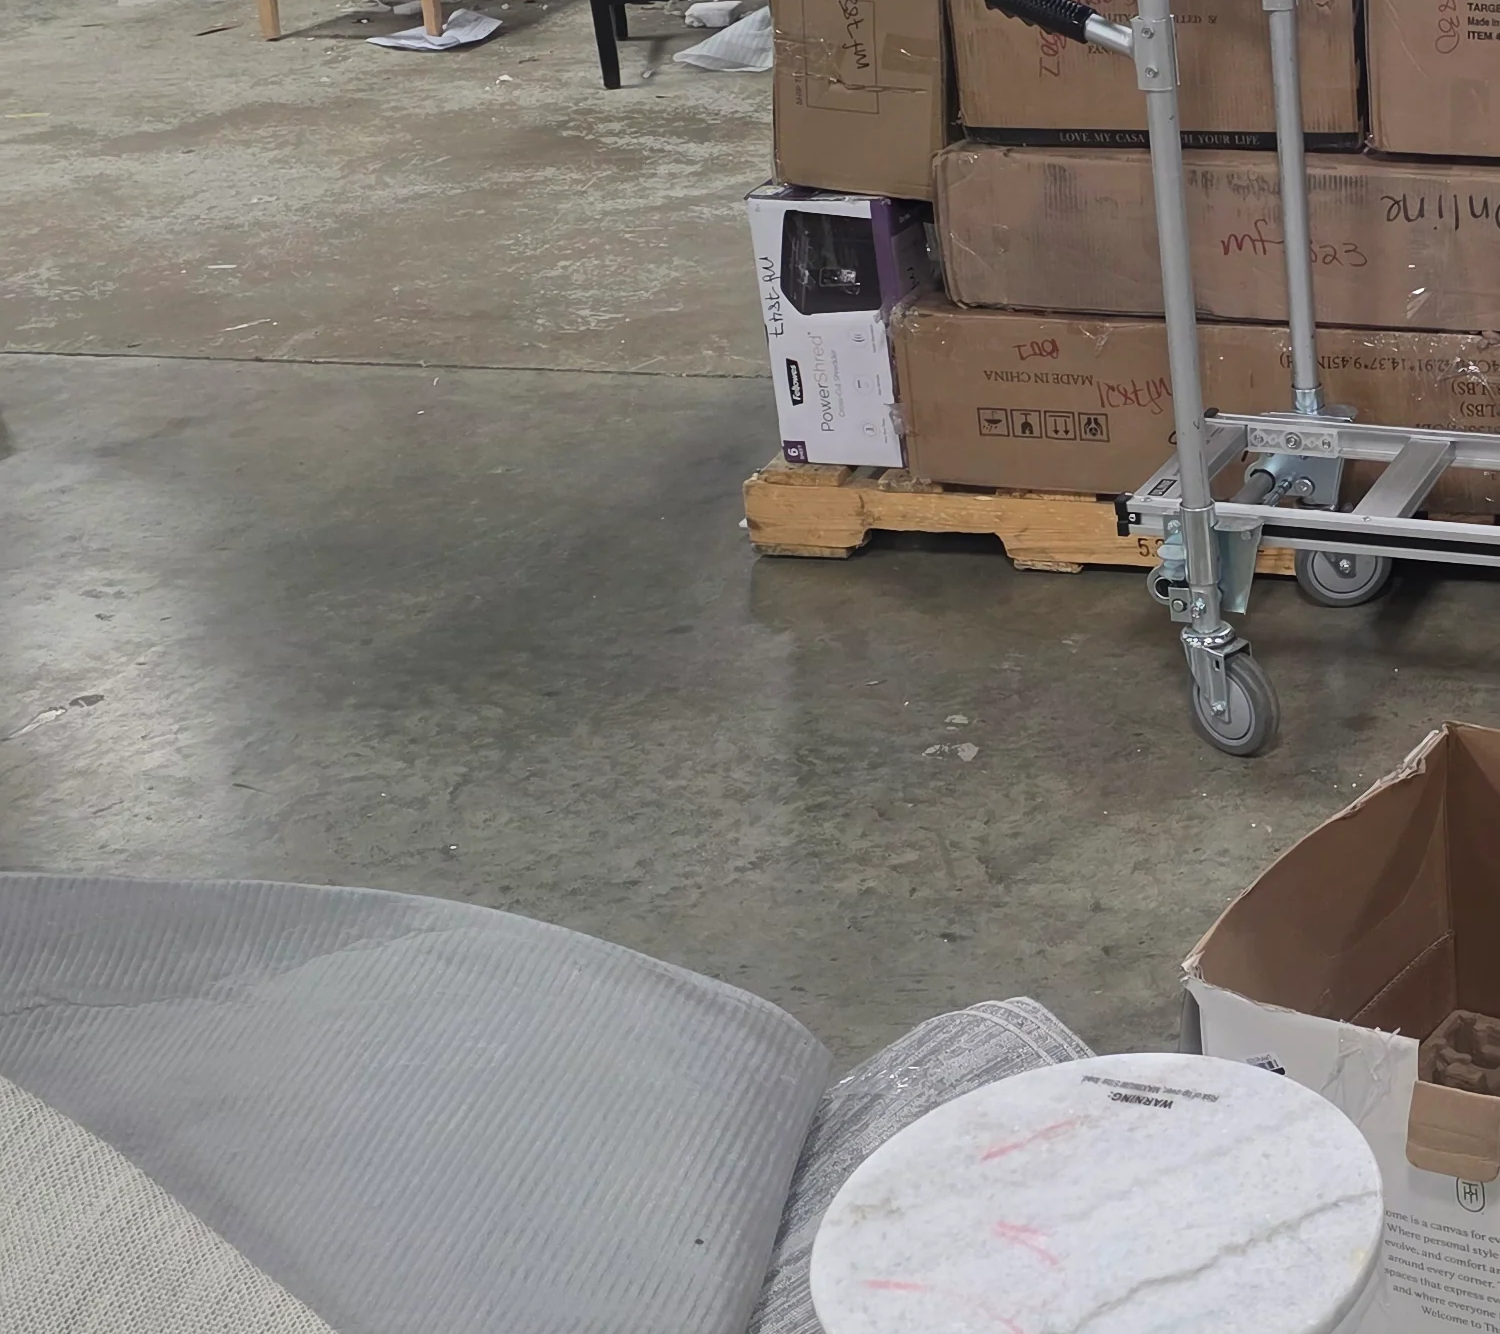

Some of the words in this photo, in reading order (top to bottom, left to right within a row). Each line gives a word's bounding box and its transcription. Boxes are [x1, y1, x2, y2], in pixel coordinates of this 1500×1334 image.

[1467, 17, 1489, 27] Made
[1467, 31, 1493, 41] ITEM
[1059, 132, 1090, 143] LOVE
[1095, 132, 1111, 143] MY
[1115, 133, 1145, 144] CASA
[1198, 134, 1230, 145] YOUR
[1235, 135, 1260, 146] LIFE
[790, 364, 802, 401] Fellowes
[812, 334, 836, 432] PowerShred
[983, 370, 1032, 384] CHINA
[1034, 372, 1050, 384] IN
[1052, 373, 1093, 386] MADE
[788, 447, 799, 457] 6
[1108, 1091, 1174, 1109] WARNING:
[1385, 1210, 1408, 1222] ome
[1410, 1214, 1419, 1225] is
[1430, 1222, 1469, 1238] canvas
[1471, 1229, 1486, 1242] for
[1387, 1222, 1421, 1241] Where
[1423, 1234, 1469, 1253] personal
[1472, 1245, 1499, 1261] style
[1384, 1239, 1420, 1255] evolve,
[1421, 1249, 1442, 1261] and
[1444, 1254, 1486, 1272] comfort
[1387, 1253, 1424, 1270] around
[1427, 1264, 1455, 1280] every
[1457, 1272, 1495, 1289] corner.
[1384, 1267, 1418, 1284] spaces
[1420, 1276, 1442, 1290] that
[1444, 1284, 1484, 1302] express
[1393, 1283, 1412, 1296] and
[1414, 1290, 1446, 1306] where
[1448, 1299, 1496, 1319] everyone
[1421, 1305, 1468, 1327] Welcome
[1471, 1319, 1482, 1329] to
